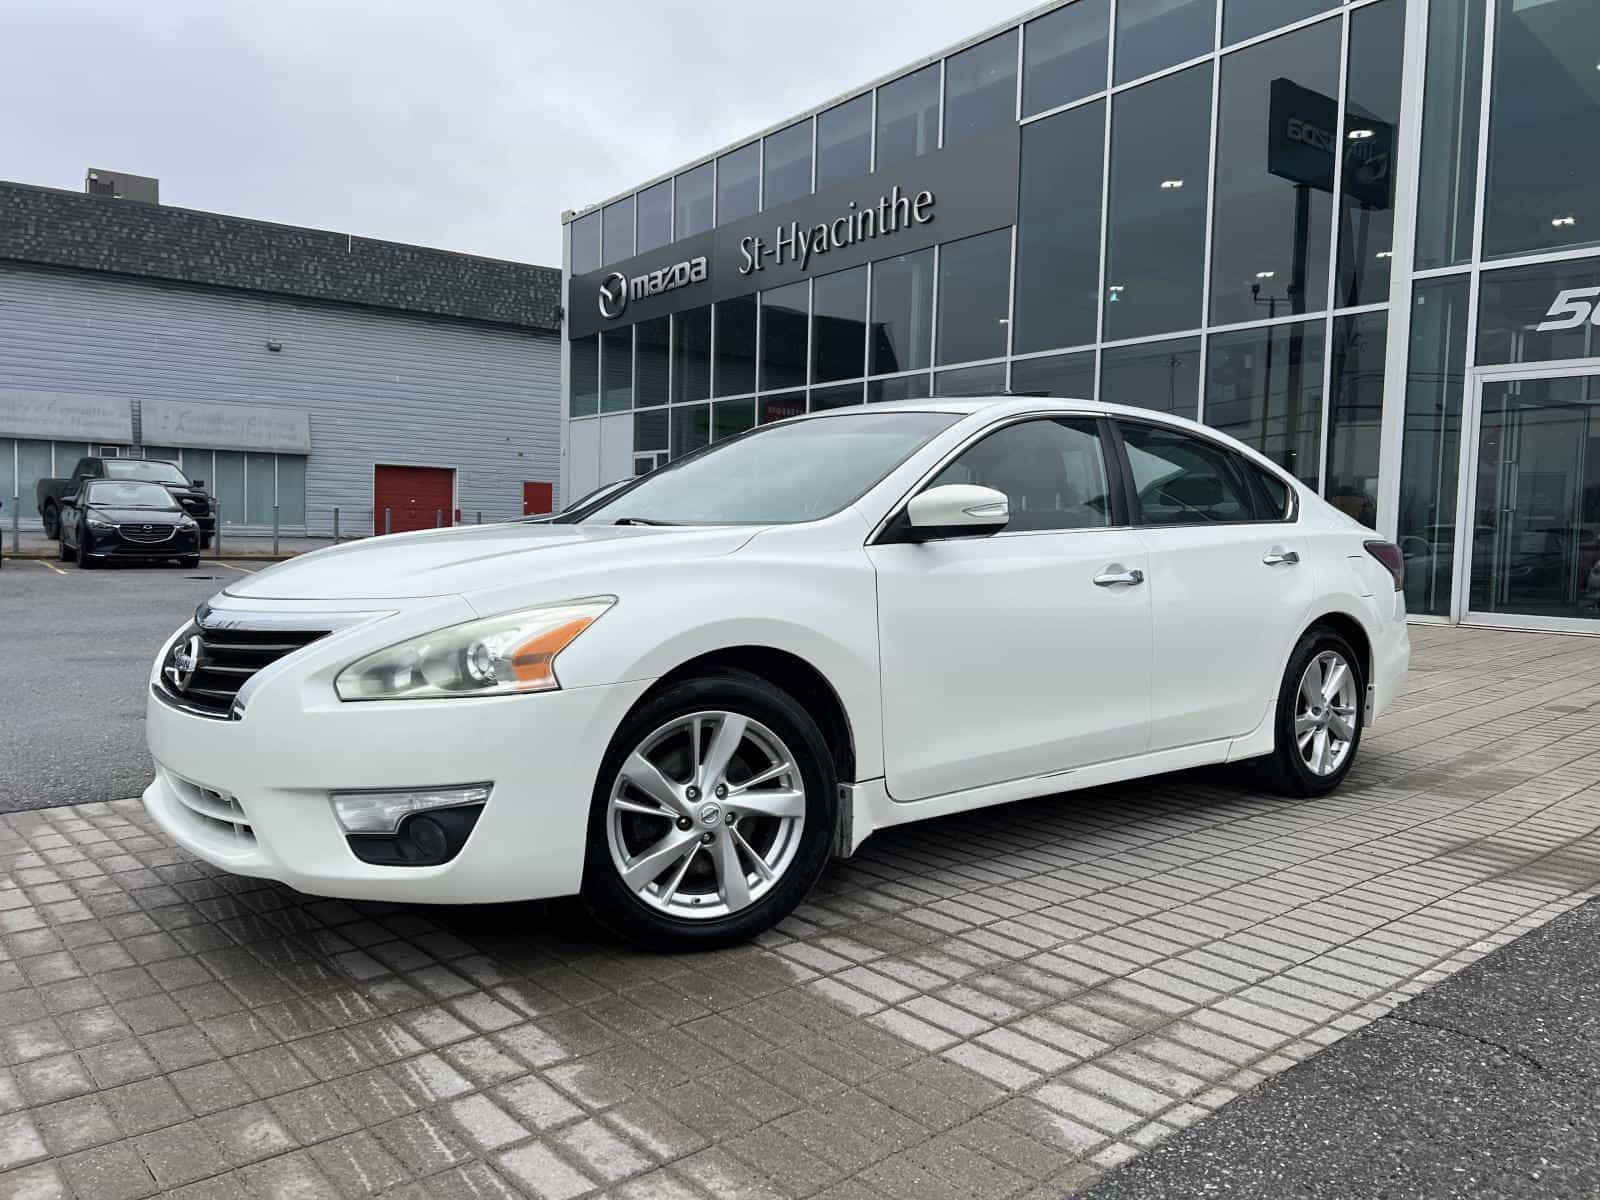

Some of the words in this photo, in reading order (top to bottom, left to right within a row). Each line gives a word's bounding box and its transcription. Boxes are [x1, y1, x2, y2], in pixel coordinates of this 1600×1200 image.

[738, 185, 934, 275] St-Hyacinthe
[630, 256, 707, 301] mazda
[1536, 286, 1600, 332] 5
